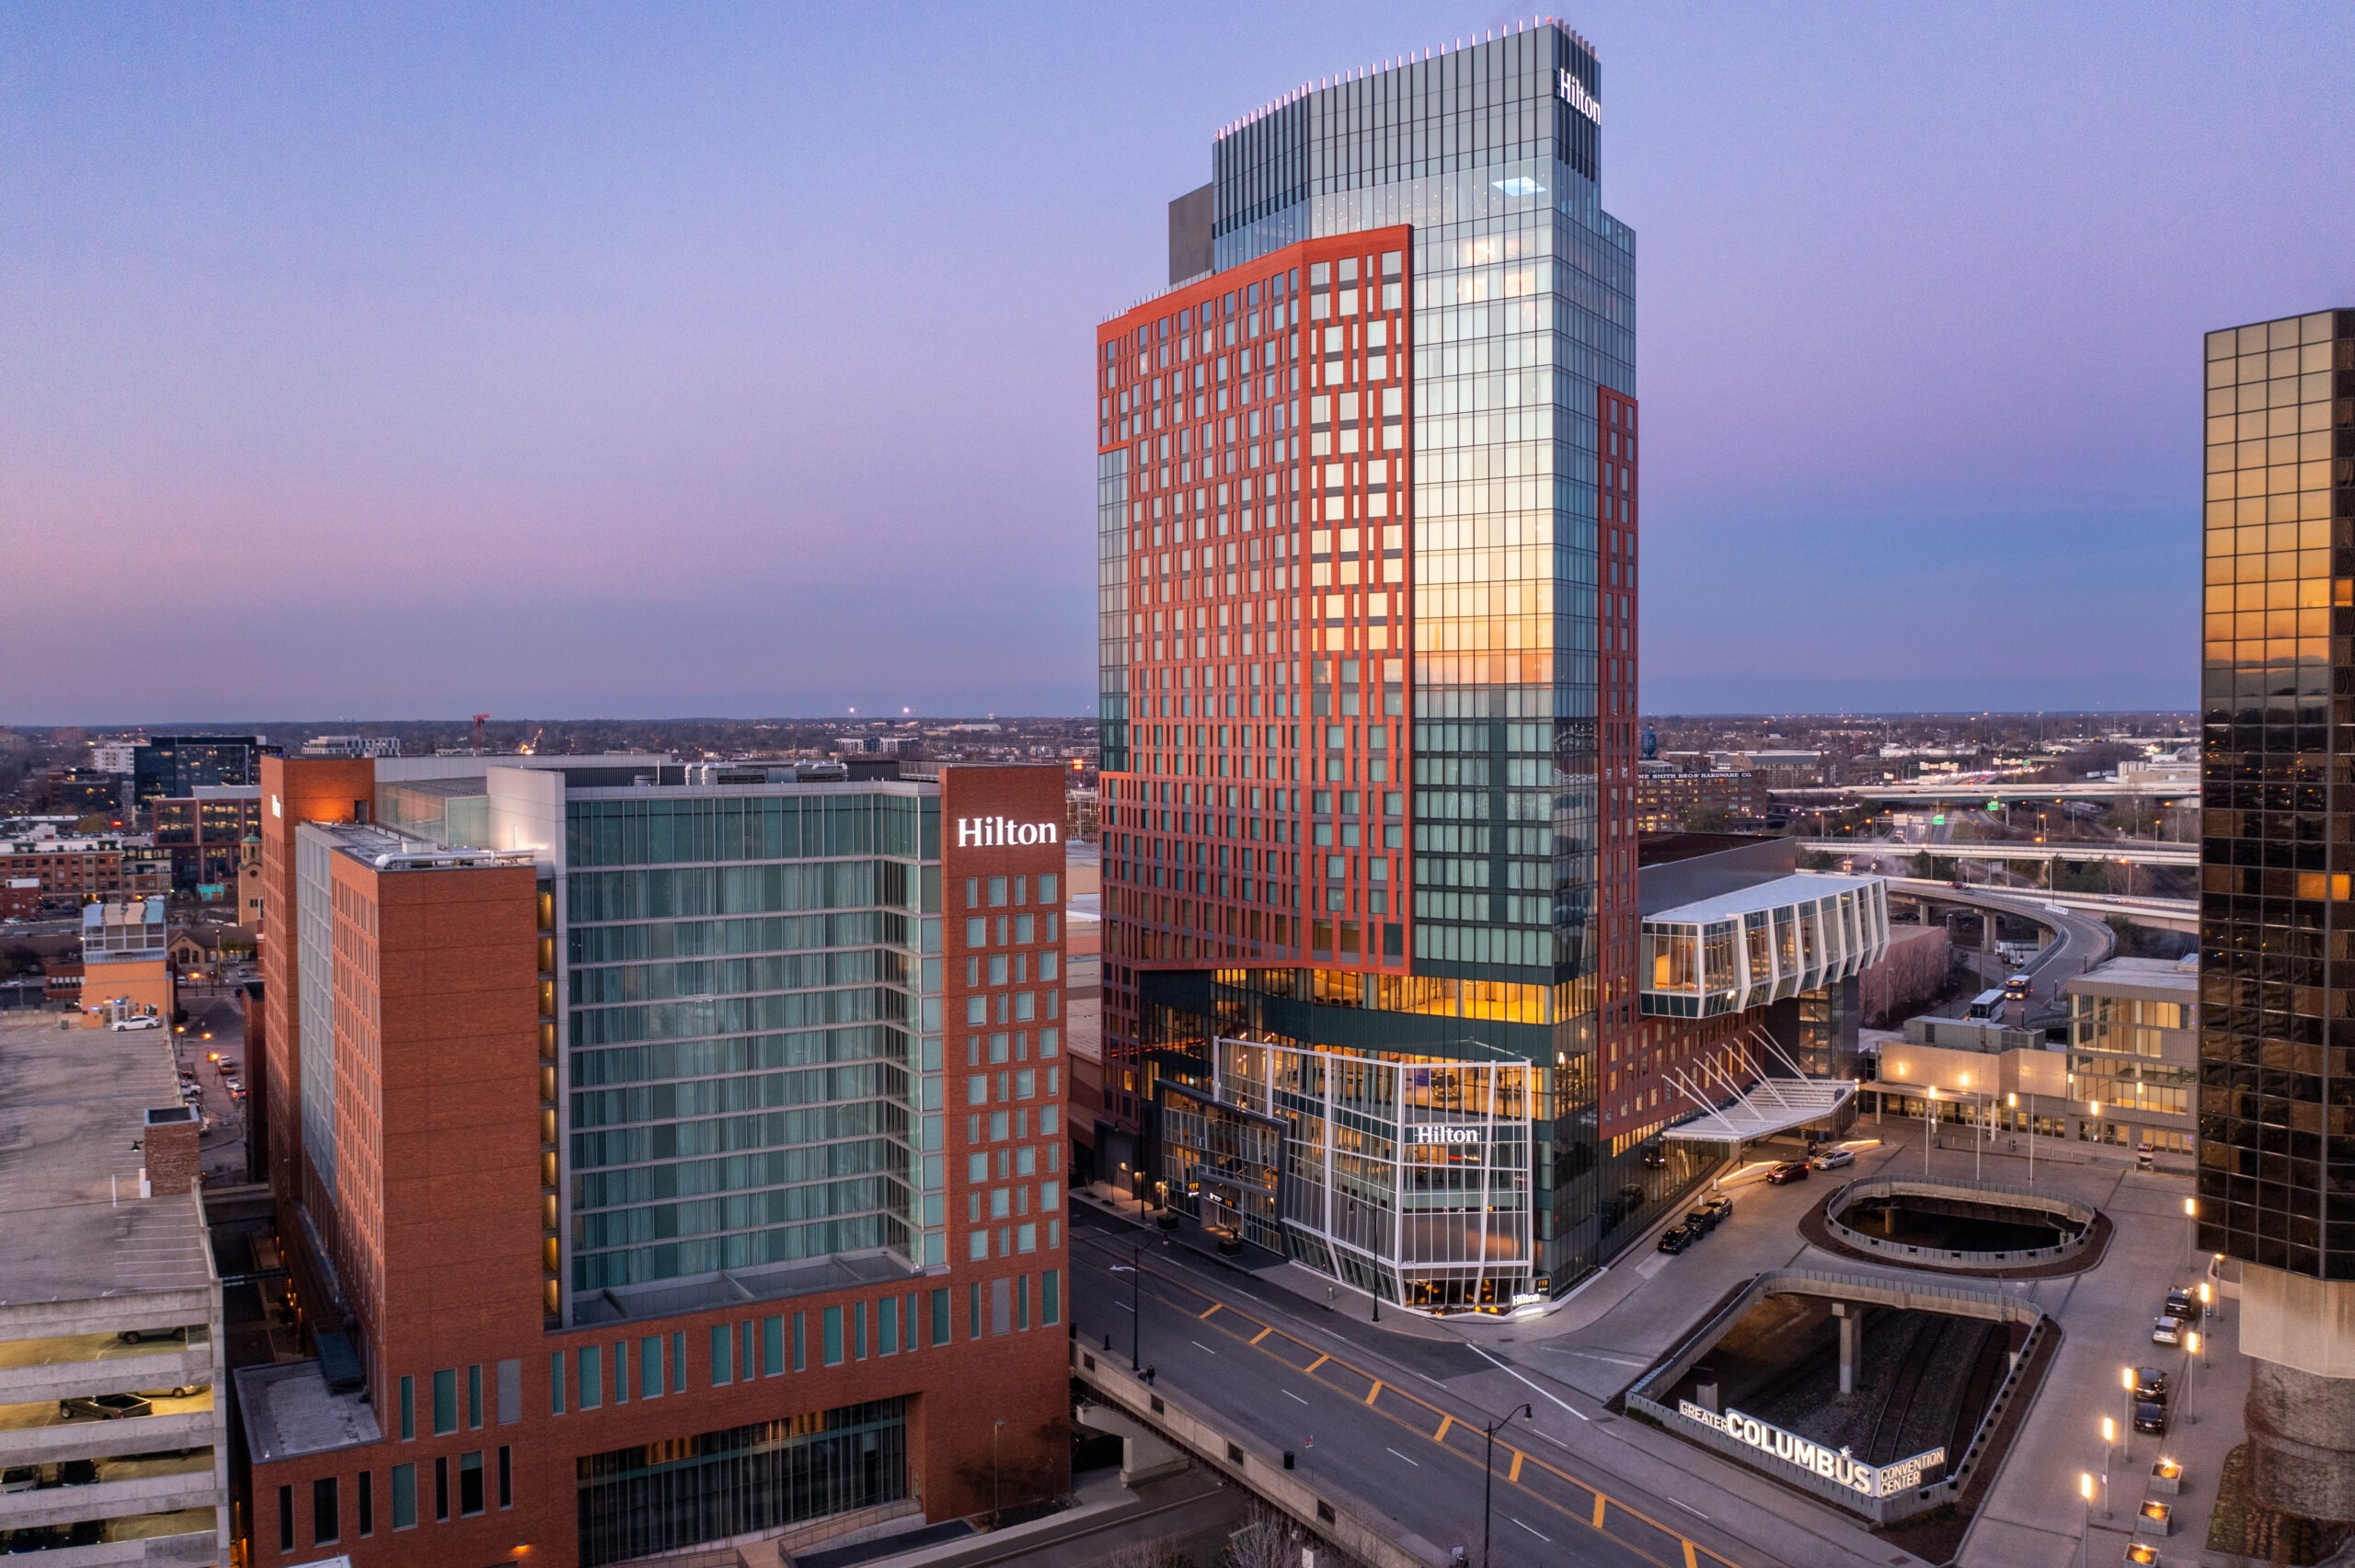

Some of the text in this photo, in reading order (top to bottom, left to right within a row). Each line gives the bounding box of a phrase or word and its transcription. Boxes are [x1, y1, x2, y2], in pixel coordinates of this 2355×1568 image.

[1560, 67, 1601, 125] Hilton
[958, 817, 1057, 847] Hilton
[1418, 1126, 1478, 1143] Hilton
[1512, 1293, 1540, 1305] Hilton
[1680, 1402, 1728, 1432] GREATER
[1727, 1412, 1871, 1494] COLUMBUS
[1879, 1449, 1944, 1482] CONVENTION
[1880, 1471, 1921, 1496] CENTER
